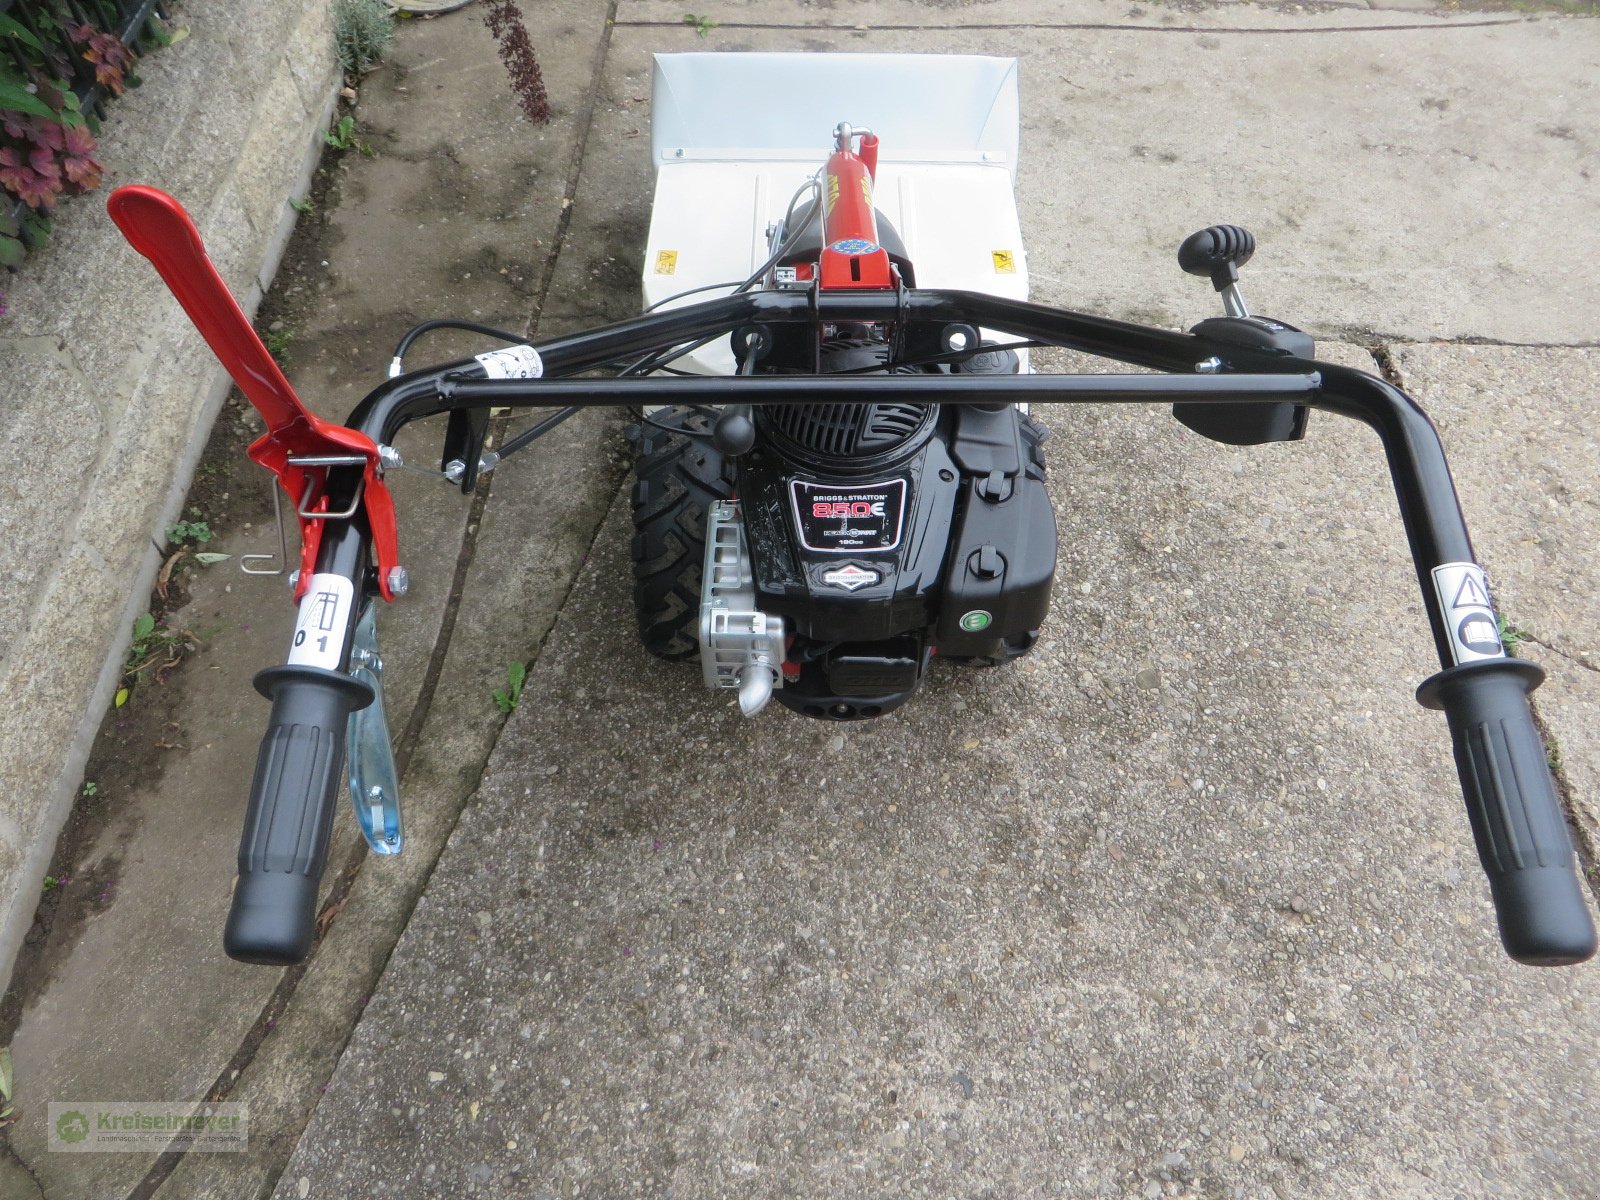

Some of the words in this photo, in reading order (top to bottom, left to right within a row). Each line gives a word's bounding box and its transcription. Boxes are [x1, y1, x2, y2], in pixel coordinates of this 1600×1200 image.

[813, 502, 885, 518] 850E
[295, 629, 306, 647] 0
[317, 635, 328, 652] 1
